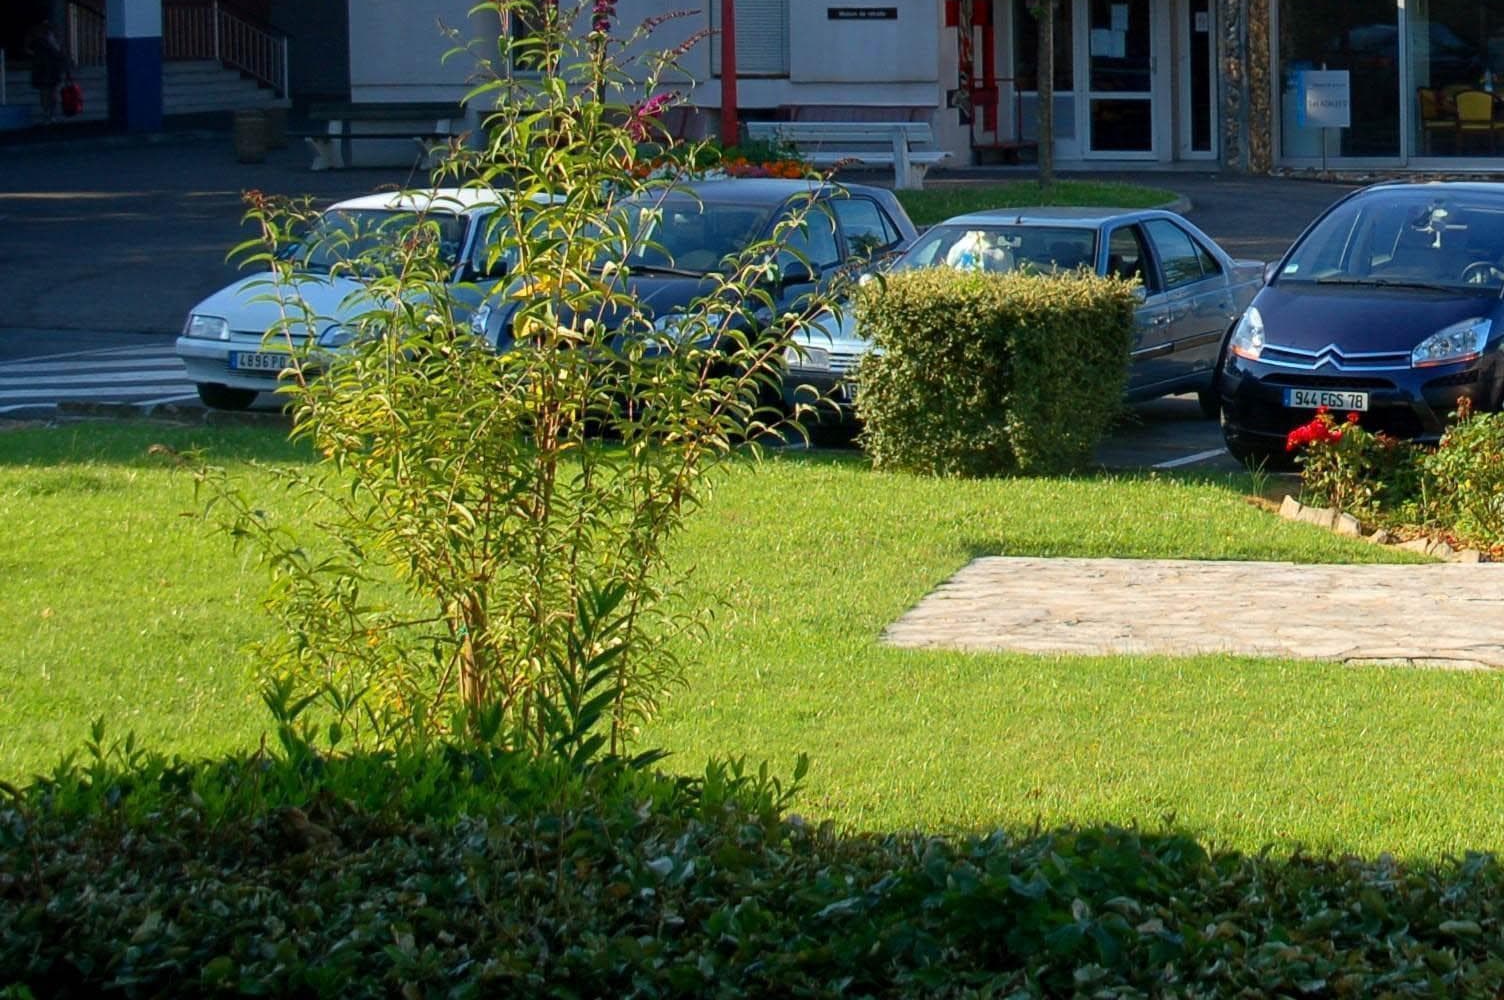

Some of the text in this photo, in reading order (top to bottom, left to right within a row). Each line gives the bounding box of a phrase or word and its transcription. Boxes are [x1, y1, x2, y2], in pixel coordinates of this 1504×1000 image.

[1295, 391, 1363, 409] 944 EGS 78
